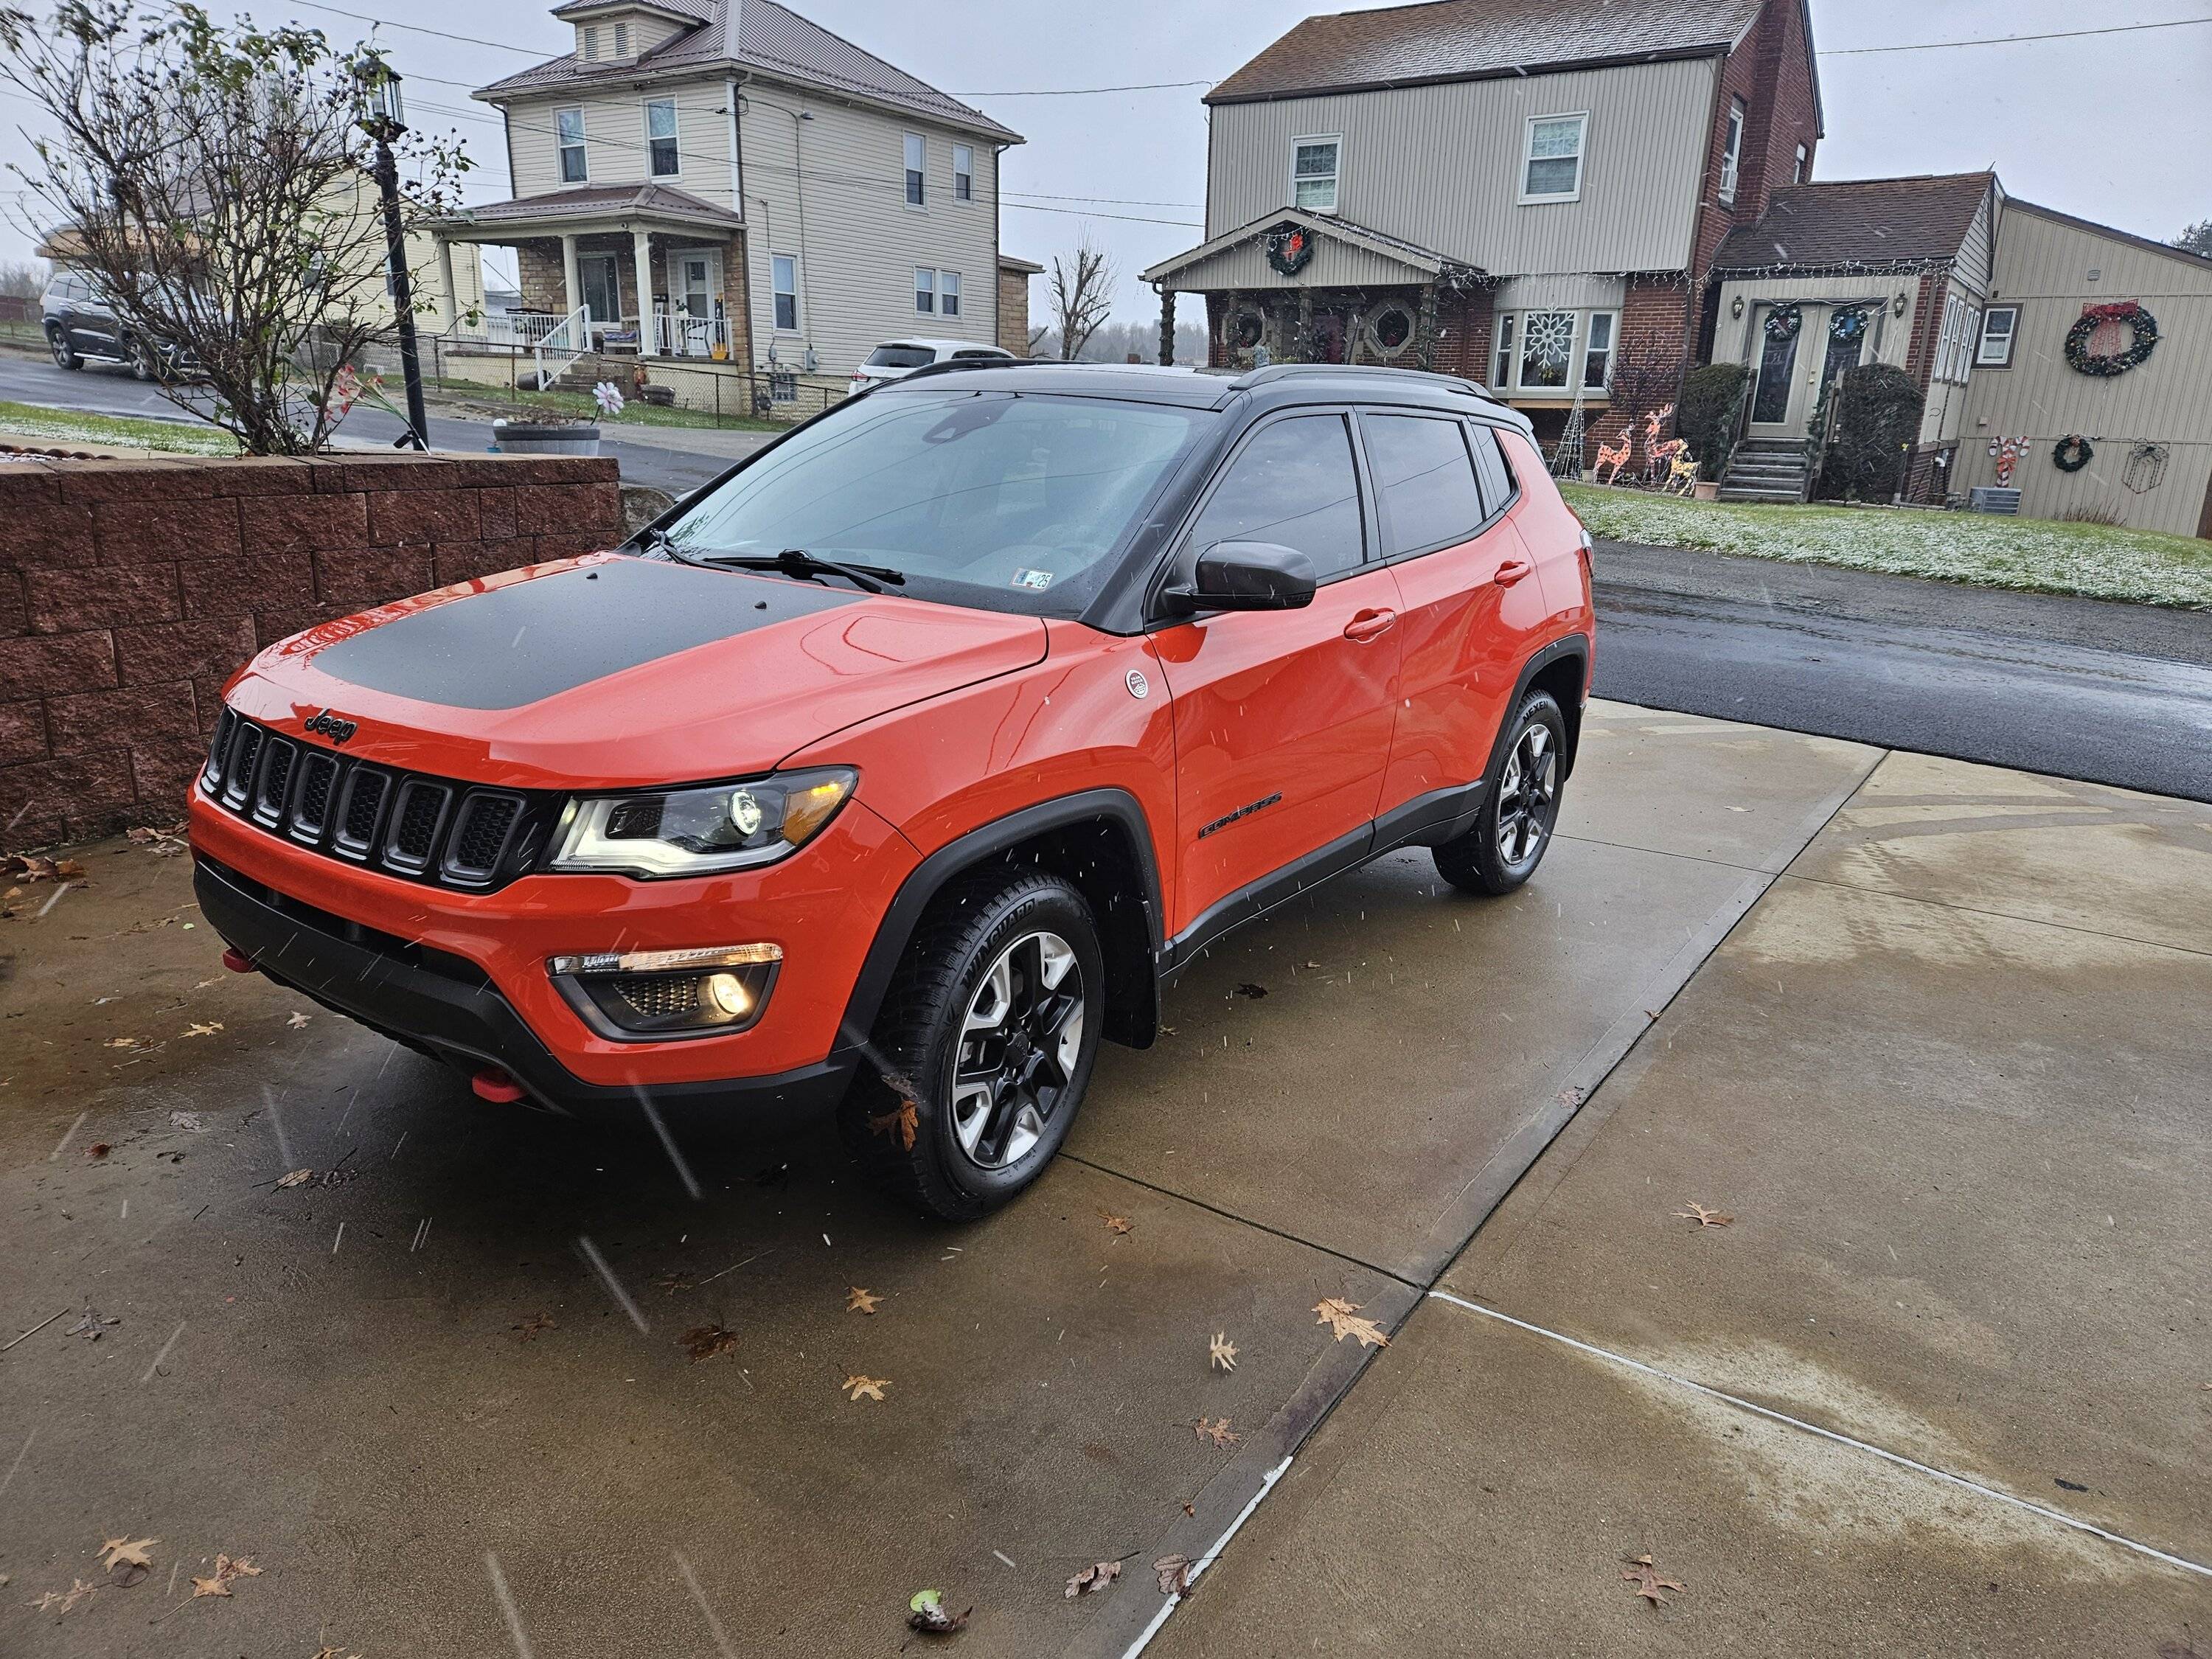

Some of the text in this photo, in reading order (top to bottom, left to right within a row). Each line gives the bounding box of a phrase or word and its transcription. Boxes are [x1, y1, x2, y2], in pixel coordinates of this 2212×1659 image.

[1037, 574, 1050, 588] 25
[304, 708, 358, 746] Jeep
[1523, 700, 1548, 723] NEXEN
[1198, 791, 1282, 839] COMPASS
[959, 897, 1035, 989] WINGUARD
